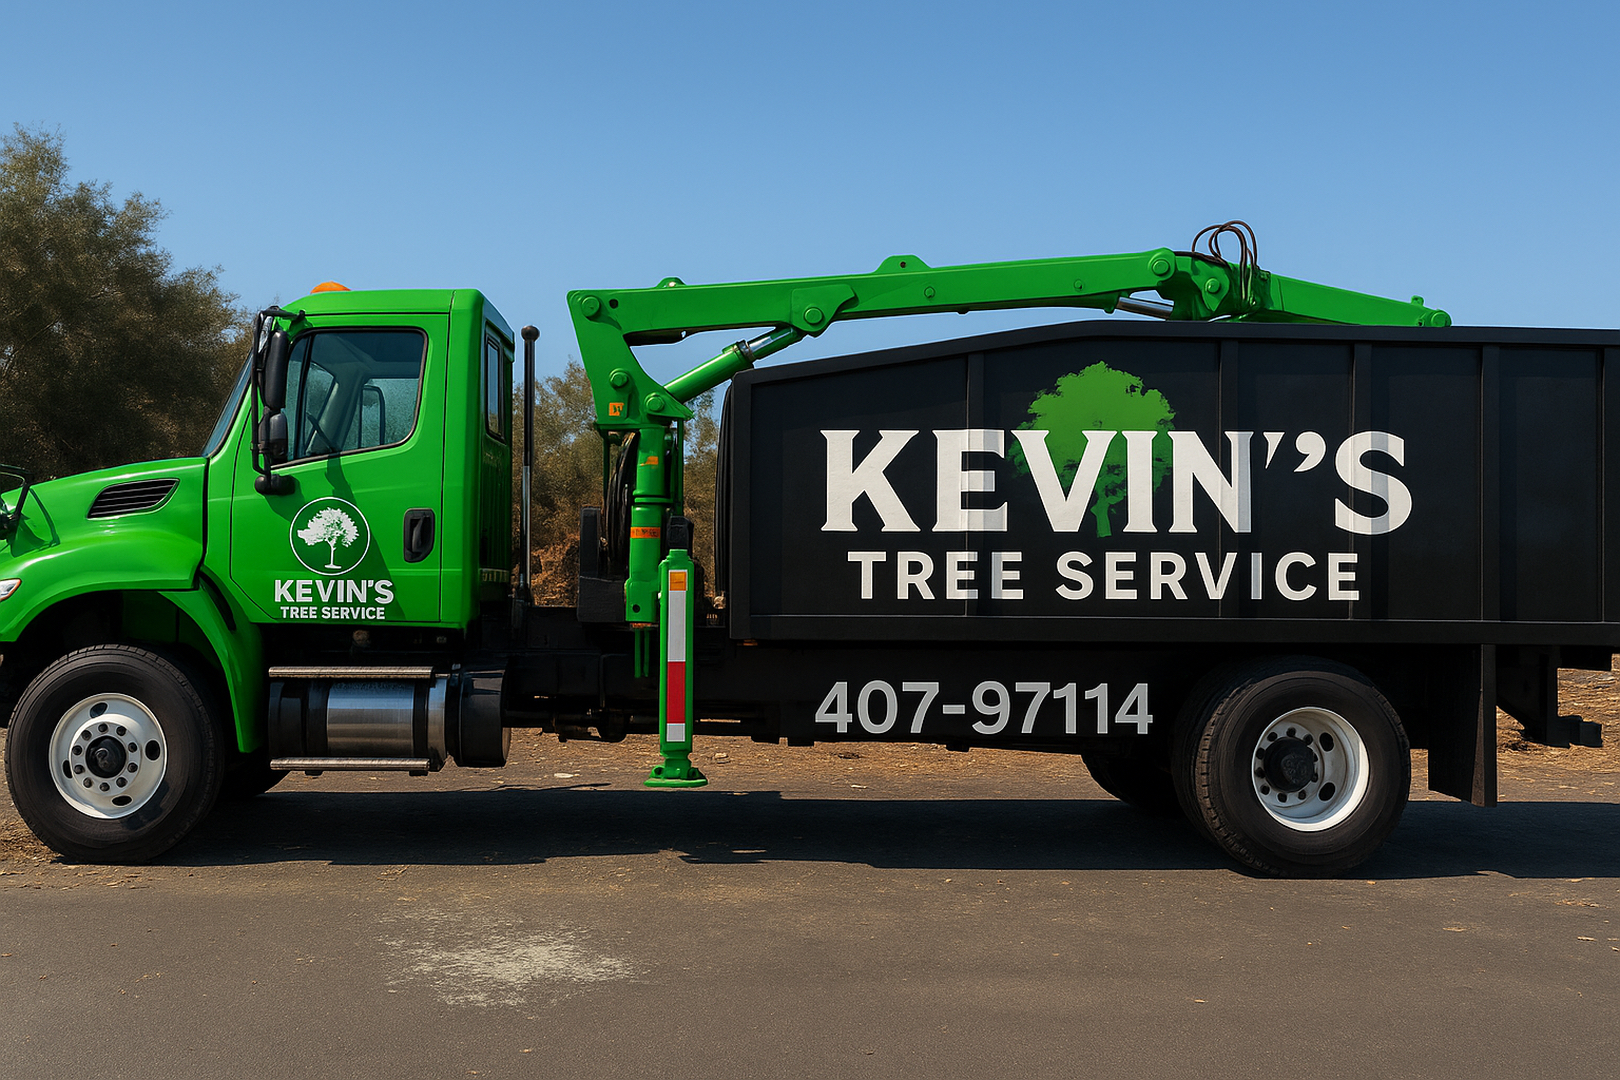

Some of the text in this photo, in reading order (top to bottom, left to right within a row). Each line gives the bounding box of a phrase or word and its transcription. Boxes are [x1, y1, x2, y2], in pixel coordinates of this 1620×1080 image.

[274, 579, 394, 605] KEVIN'S
[847, 551, 1361, 601] TREE SERVICE
[280, 606, 386, 620] TREE SERVICE
[814, 679, 1154, 735] 407-97114
